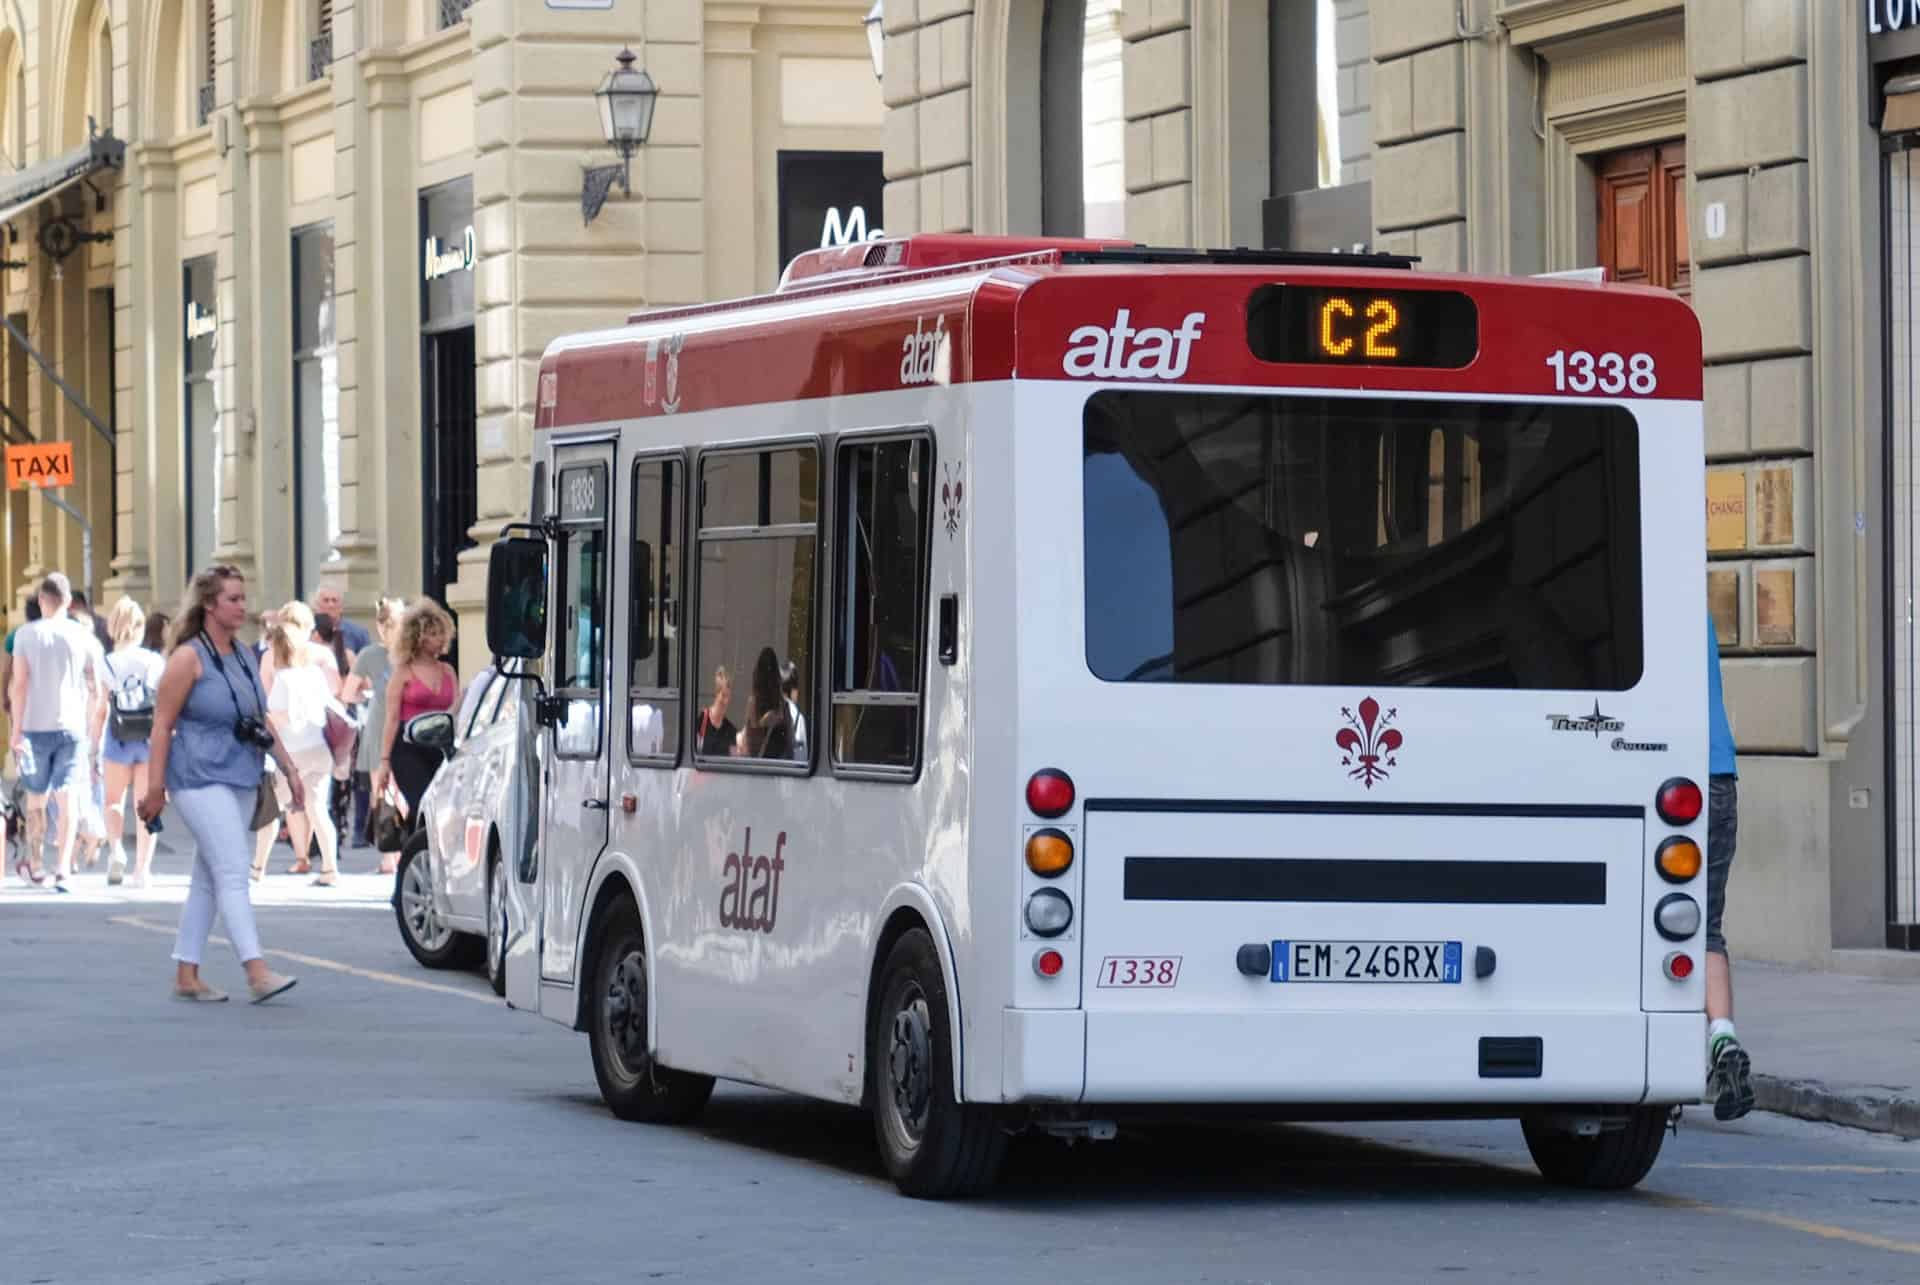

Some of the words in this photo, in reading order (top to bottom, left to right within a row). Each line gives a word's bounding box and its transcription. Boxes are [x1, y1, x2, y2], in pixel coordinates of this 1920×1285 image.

[901, 313, 946, 384] ataf
[1062, 308, 1205, 380] ataf
[1546, 350, 1657, 394] 1338
[10, 454, 69, 477] TAXI
[570, 475, 595, 512] 1338
[720, 826, 787, 934] ataf
[1108, 960, 1174, 984] 1338
[1295, 944, 1331, 977] EM
[1345, 945, 1439, 979] 246RX
